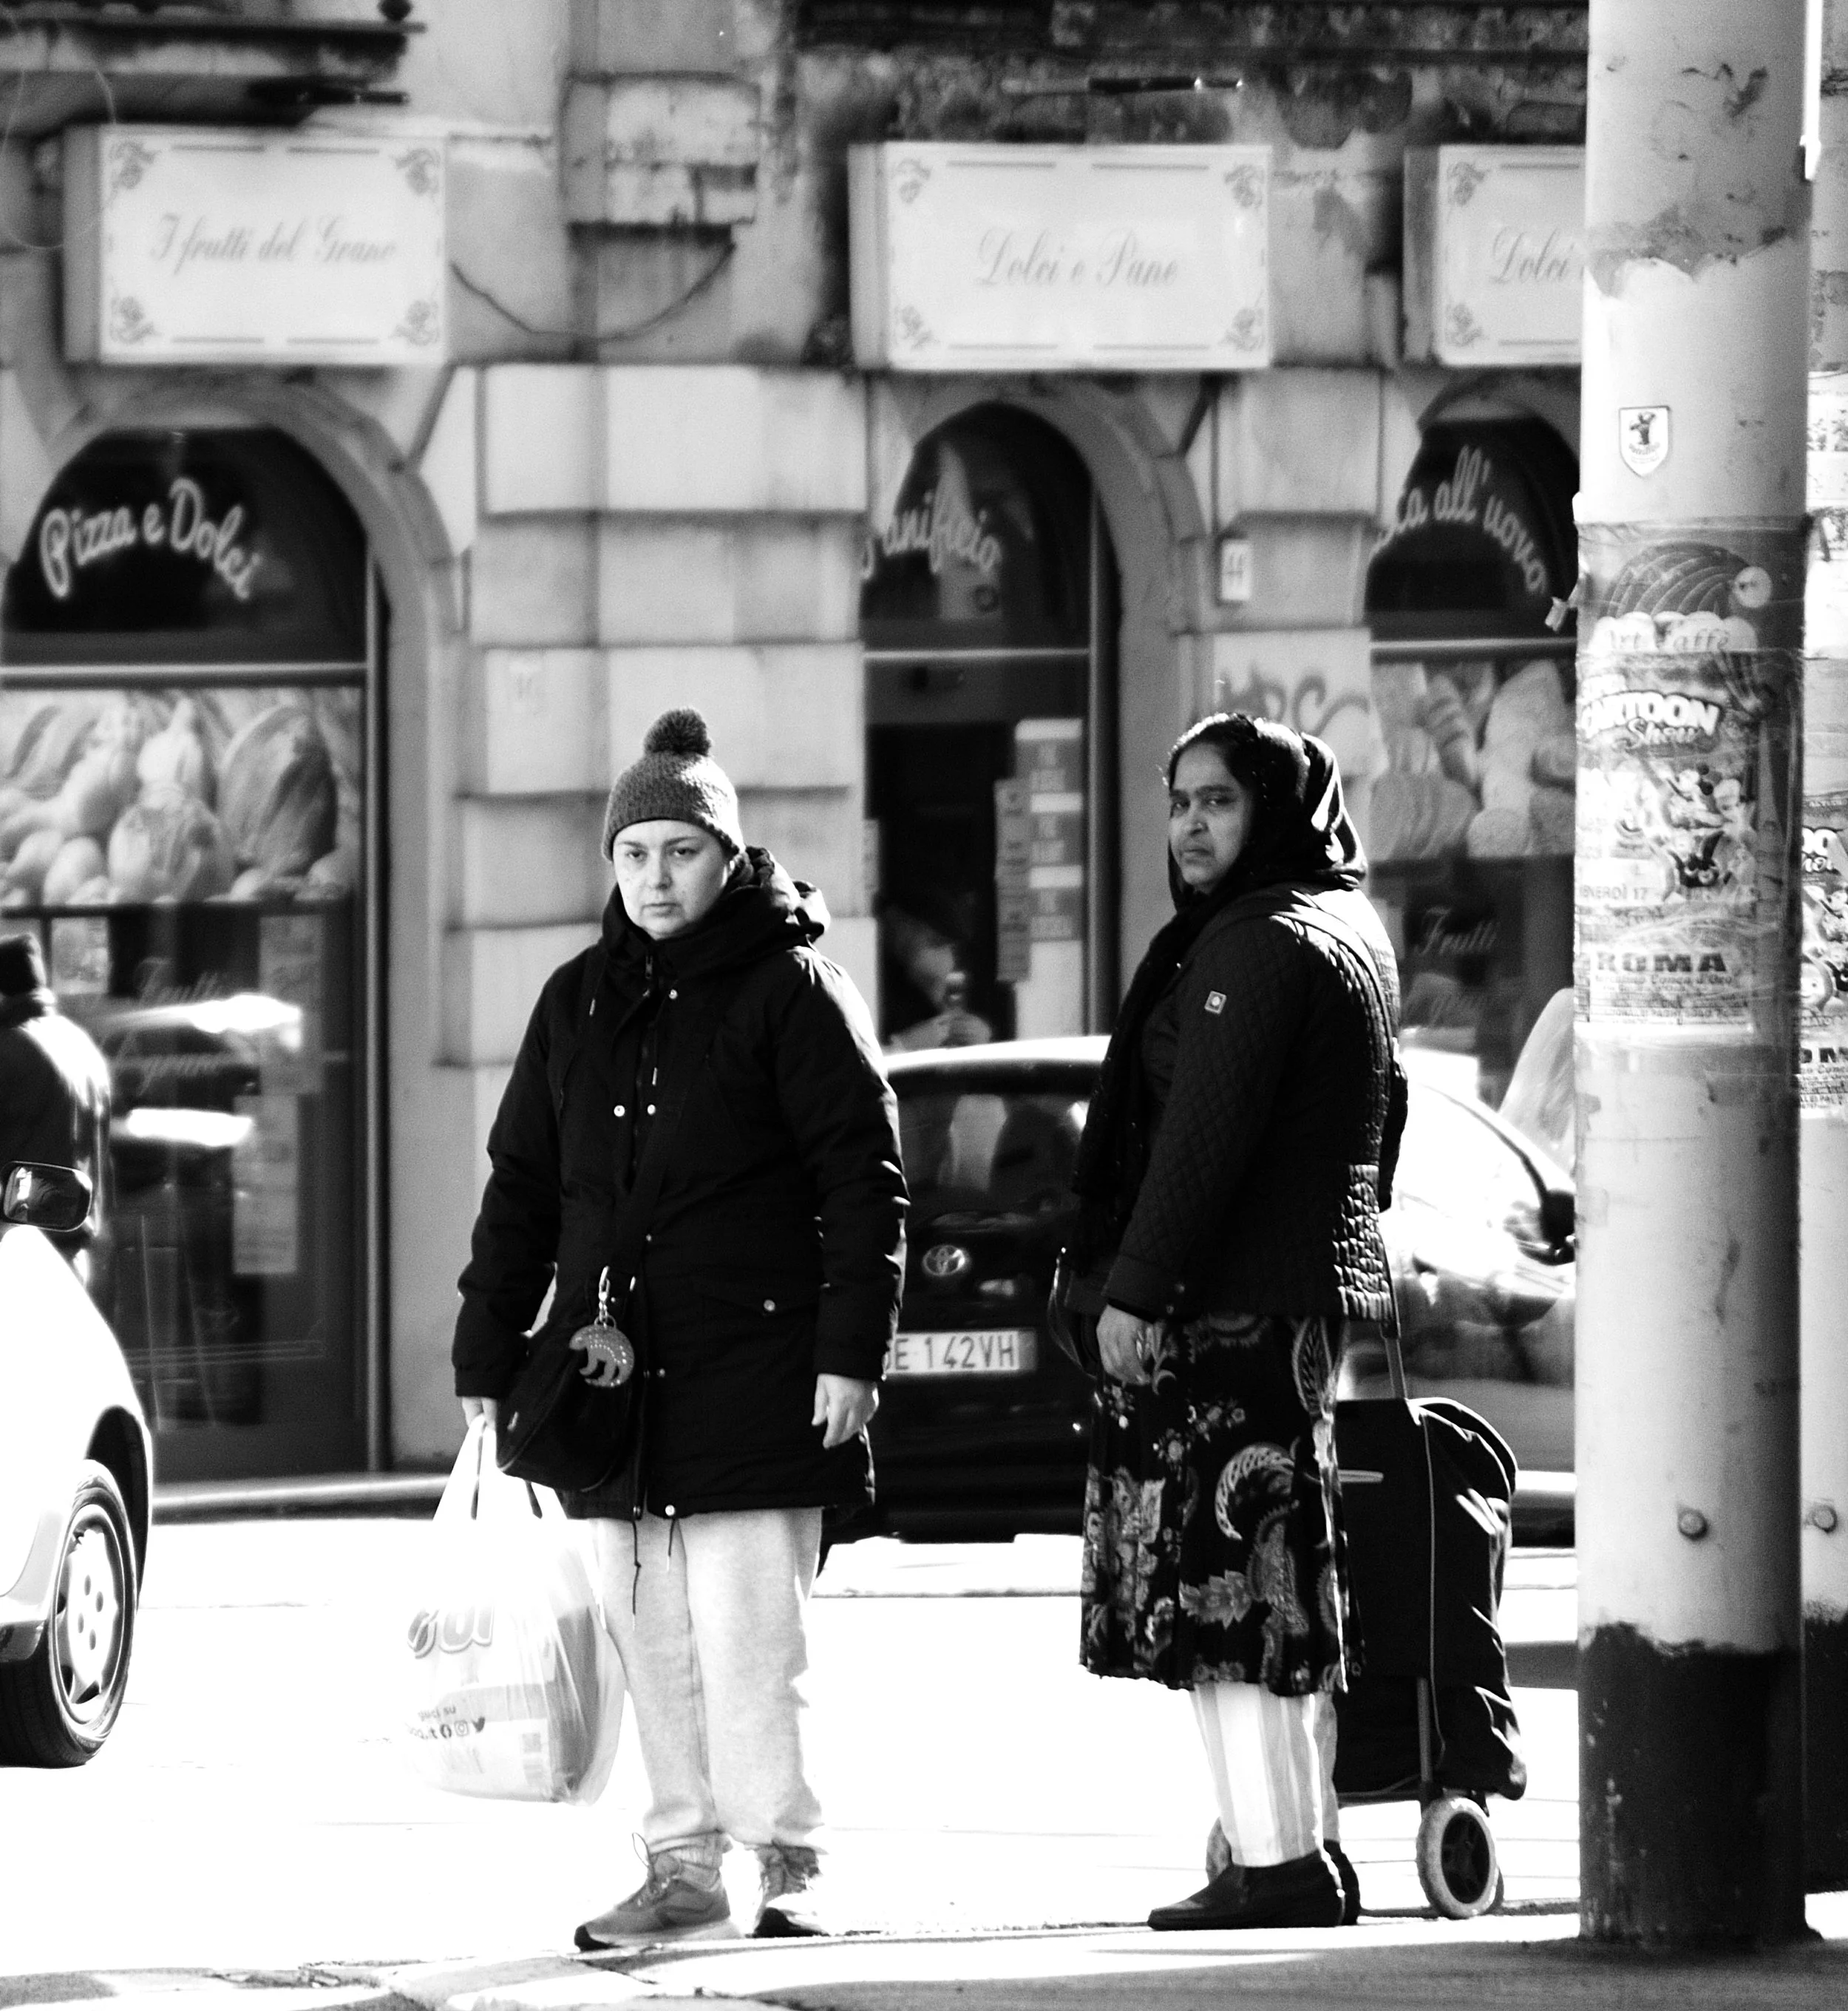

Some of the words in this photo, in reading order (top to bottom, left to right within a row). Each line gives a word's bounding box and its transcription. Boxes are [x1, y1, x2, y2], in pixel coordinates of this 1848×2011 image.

[173, 217, 253, 275] frutti
[258, 217, 299, 262] del
[313, 216, 398, 264] Grano
[974, 225, 1067, 288] Dolci
[1069, 256, 1088, 288] e
[1095, 225, 1181, 288] Pane
[1488, 224, 1576, 285] Dolci
[39, 505, 137, 600] Pizza
[142, 503, 165, 546] e
[169, 477, 262, 600] Dolci
[925, 1335, 1015, 1369] 142VH
